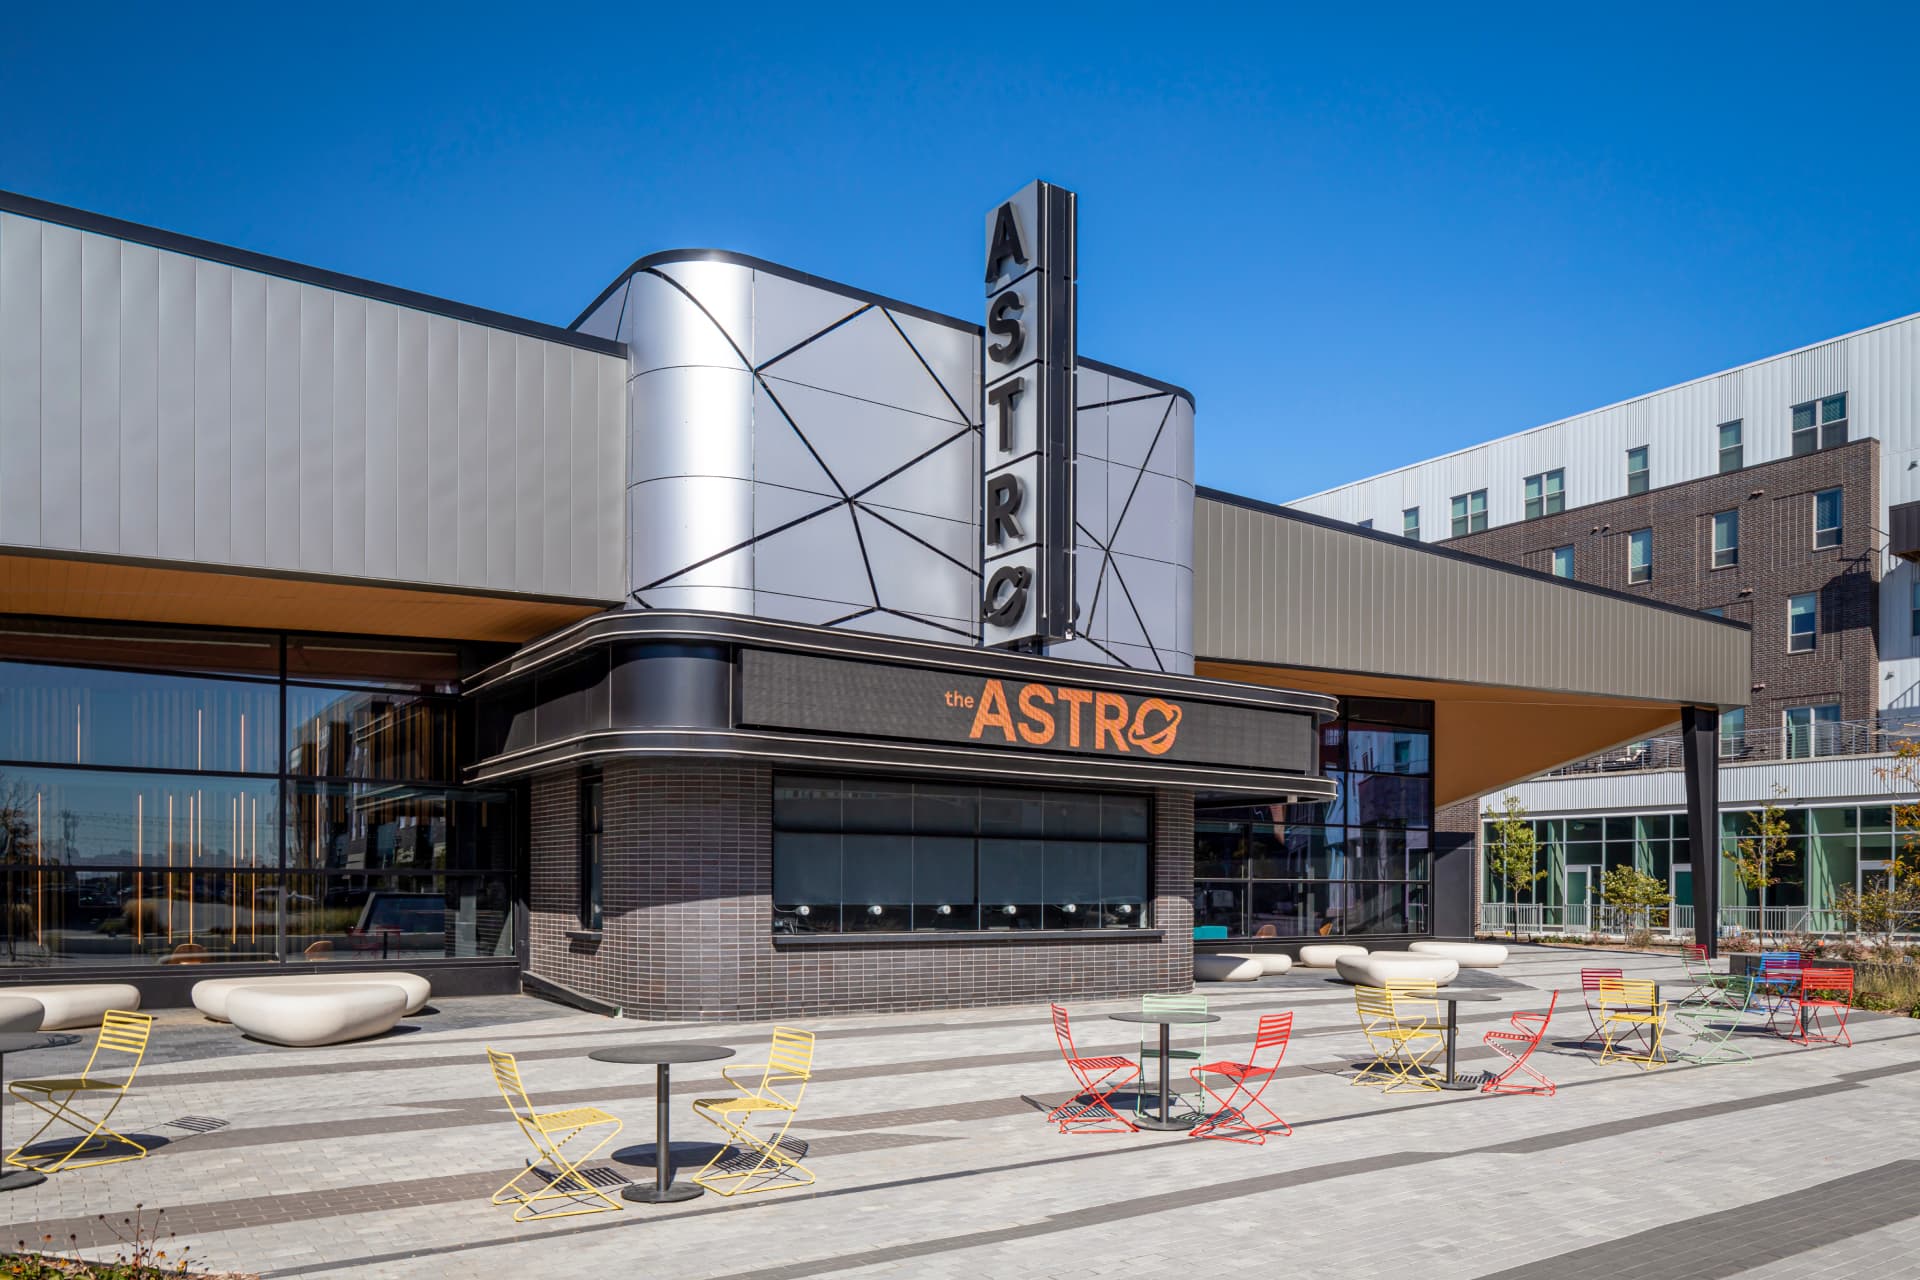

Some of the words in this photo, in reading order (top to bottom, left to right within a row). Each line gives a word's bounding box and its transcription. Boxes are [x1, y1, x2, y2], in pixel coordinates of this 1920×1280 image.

[984, 201, 1031, 627] ASTRO
[945, 690, 974, 708] the
[969, 679, 1182, 755] ASTRO
